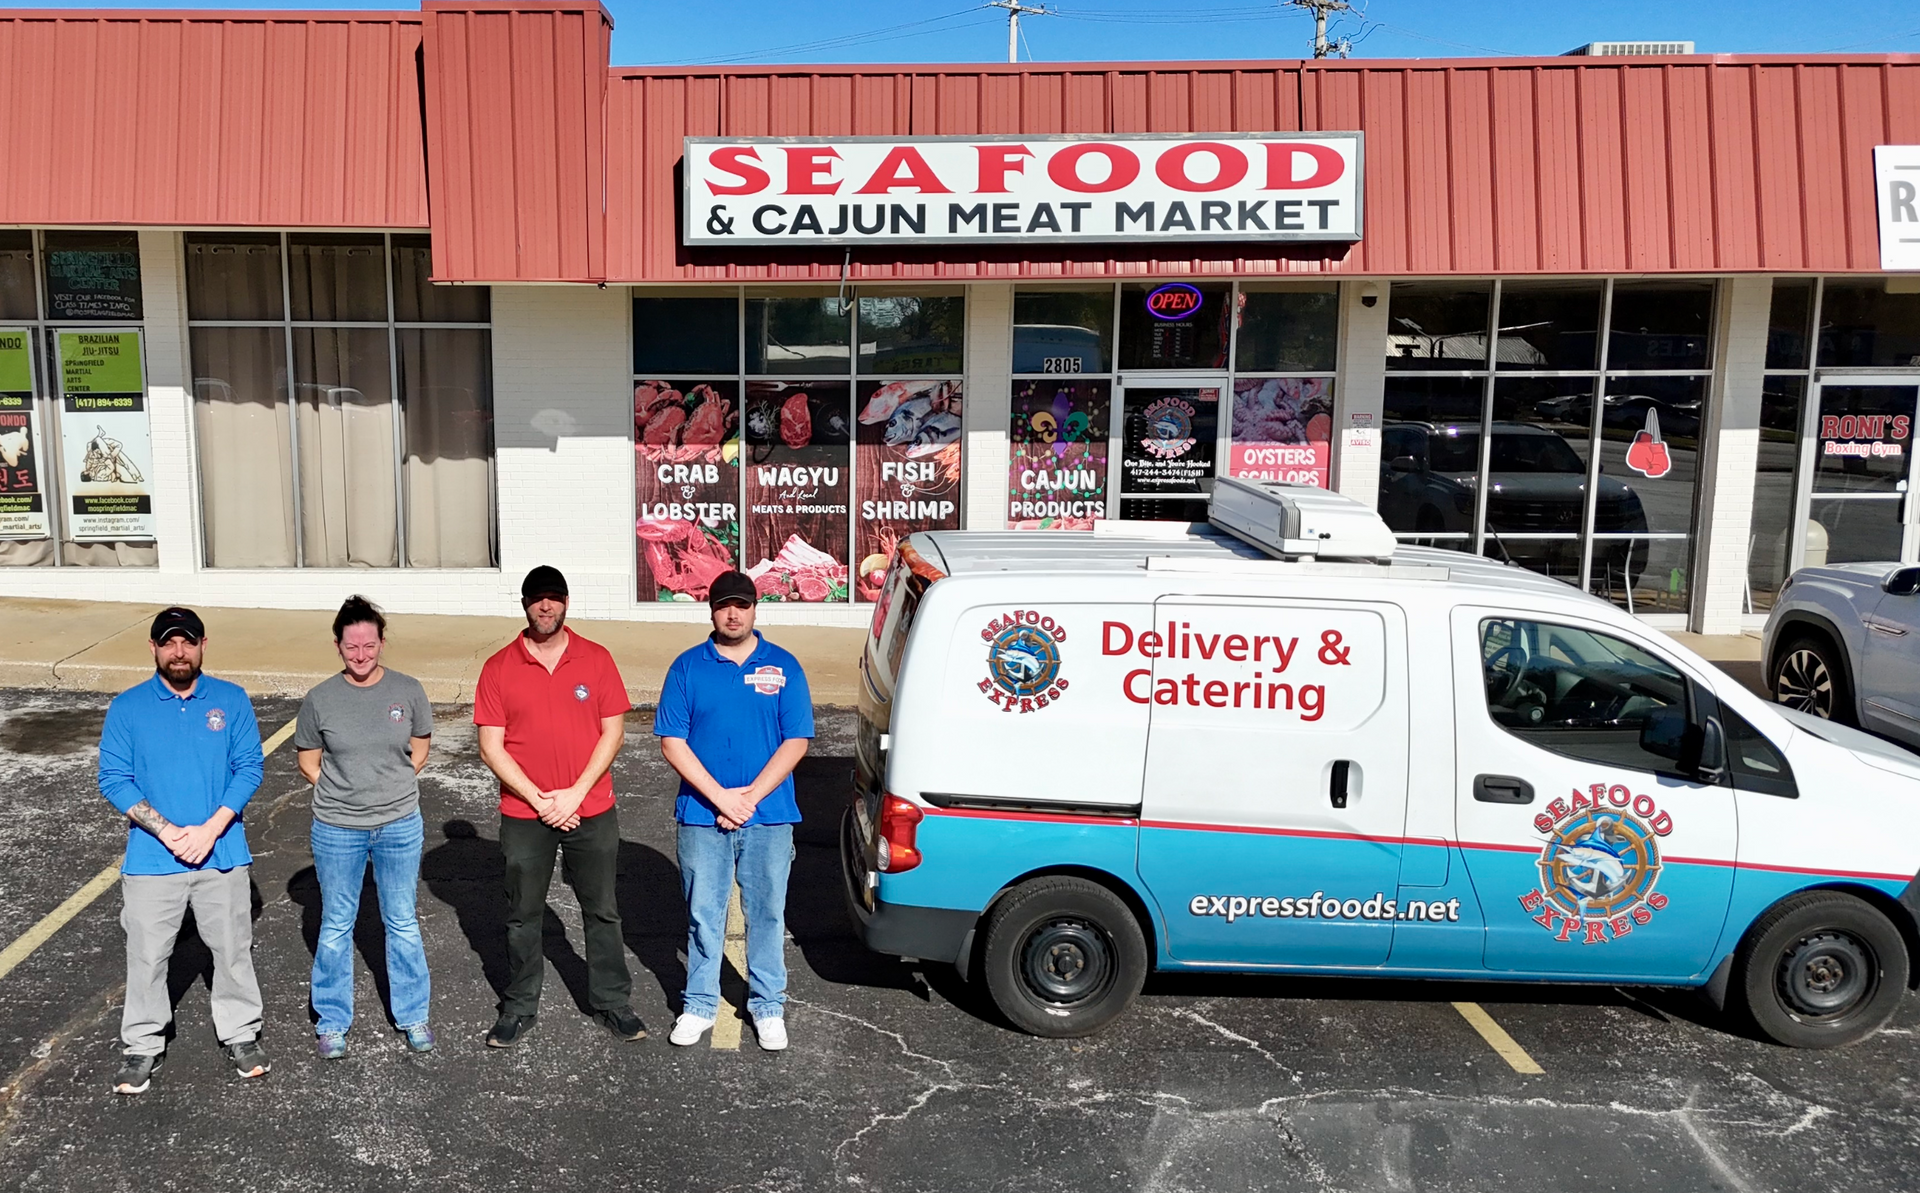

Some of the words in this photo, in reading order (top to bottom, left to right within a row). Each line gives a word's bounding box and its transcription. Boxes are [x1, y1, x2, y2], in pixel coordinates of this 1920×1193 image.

[703, 142, 1346, 197] SEAFOOD
[706, 204, 735, 235] &
[752, 203, 924, 235] CAJUN
[948, 201, 1091, 234] MEAT
[1115, 199, 1339, 233] MARKET
[51, 251, 135, 267] SPRINGFIELD
[50, 265, 105, 278] MARTIAL
[110, 267, 138, 280] ARTS
[68, 277, 120, 291] CENTER
[54, 300, 77, 309] CLASS
[1150, 293, 1197, 309] OPEN
[78, 335, 120, 344] BRAZILIAN
[82, 347, 119, 355] JIU-JITSU
[1045, 358, 1080, 373] 2805
[75, 398, 96, 408] (417)
[97, 398, 133, 407] 894-6339
[1143, 397, 1196, 418] SEAFOOD
[1820, 414, 1910, 439] RONI'S
[1140, 437, 1197, 459] EXPRESS
[1243, 448, 1316, 465] OYSTERS
[1825, 441, 1870, 457] Boxing
[1872, 441, 1902, 457] Gym
[882, 462, 935, 482] FISH
[1124, 459, 1138, 467] One
[1139, 459, 1154, 468] Bite,
[1167, 459, 1185, 468] You're
[1186, 460, 1211, 468] Hooked
[658, 464, 719, 483] CRAB
[757, 467, 839, 487] WAGYU
[1021, 469, 1096, 490] CAJUN
[1137, 477, 1196, 487] www.expressfoods.net
[680, 485, 696, 499] &
[779, 487, 797, 499] And
[797, 488, 818, 500] Local
[88, 505, 137, 513] mospringfieldmac
[642, 503, 736, 521] LOBSTER
[752, 505, 784, 514] MEATS
[785, 505, 794, 514] &
[795, 505, 846, 514] PRODUCTS
[862, 501, 955, 520] SHRIMP
[1010, 501, 1105, 517] PRODUCTS
[981, 610, 1067, 643] SEAFOOD
[1101, 621, 1299, 673] Delivery
[1317, 629, 1352, 666] &
[977, 677, 1069, 714] EXPRESS
[1122, 668, 1326, 722] Catering
[1533, 783, 1674, 837] SEAFOOD
[1188, 890, 1461, 923] expressfoods.net
[1518, 888, 1669, 945] EXPRESS
